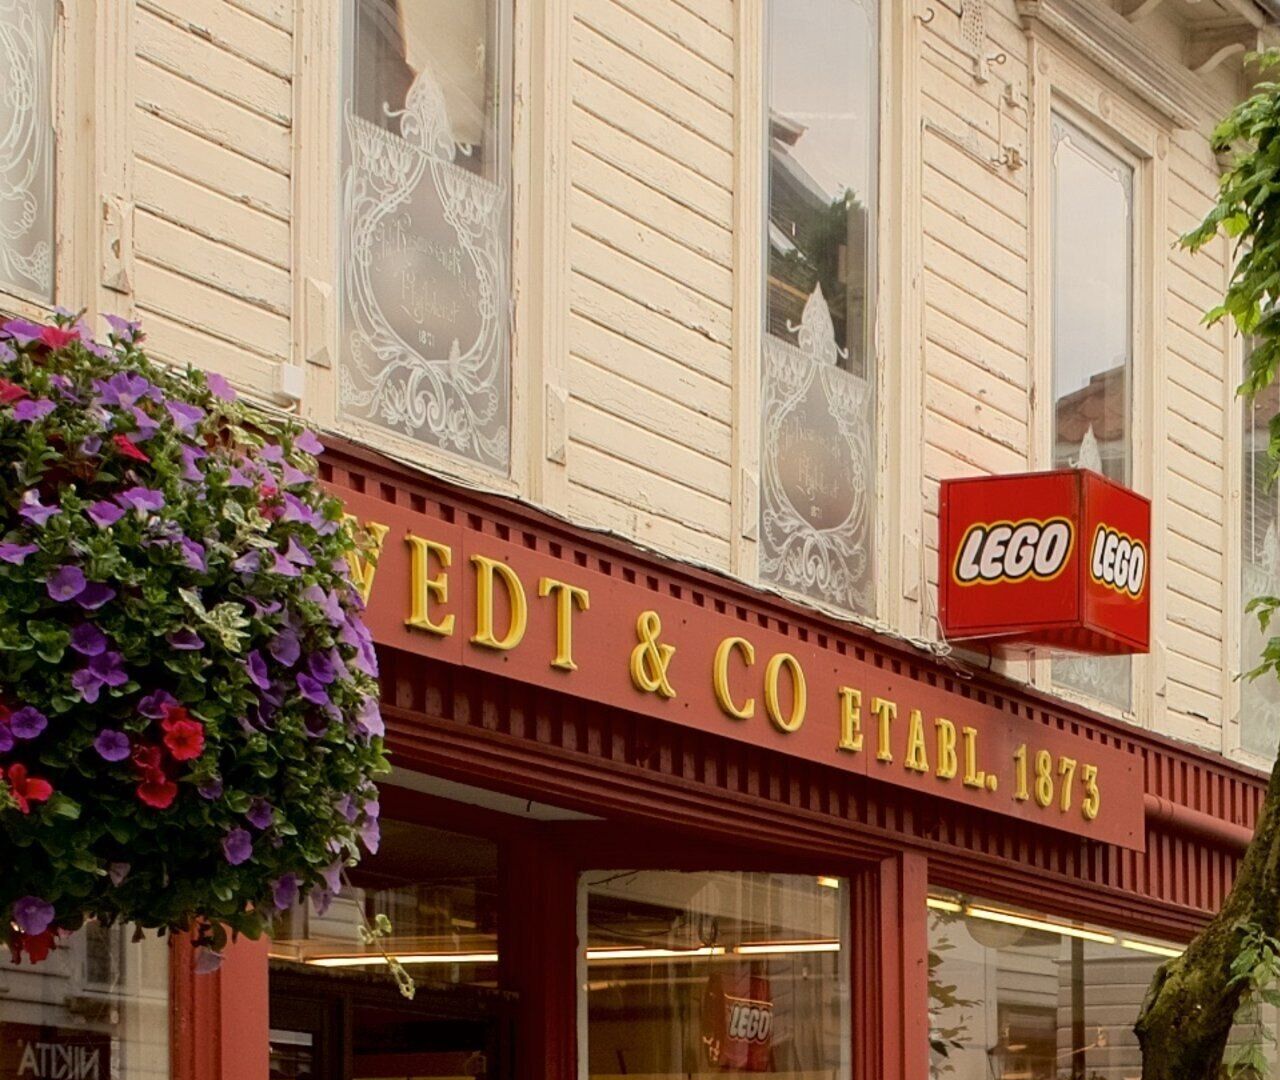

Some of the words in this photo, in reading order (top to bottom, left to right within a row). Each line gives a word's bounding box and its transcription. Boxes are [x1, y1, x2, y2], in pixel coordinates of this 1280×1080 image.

[956, 519, 1073, 584] LEGO
[1091, 527, 1146, 596] LEGO
[631, 610, 676, 698] &
[713, 637, 807, 732] CO
[838, 686, 998, 792] ETABL.
[1013, 744, 1100, 820] 1873
[729, 1005, 771, 1042] LEGO
